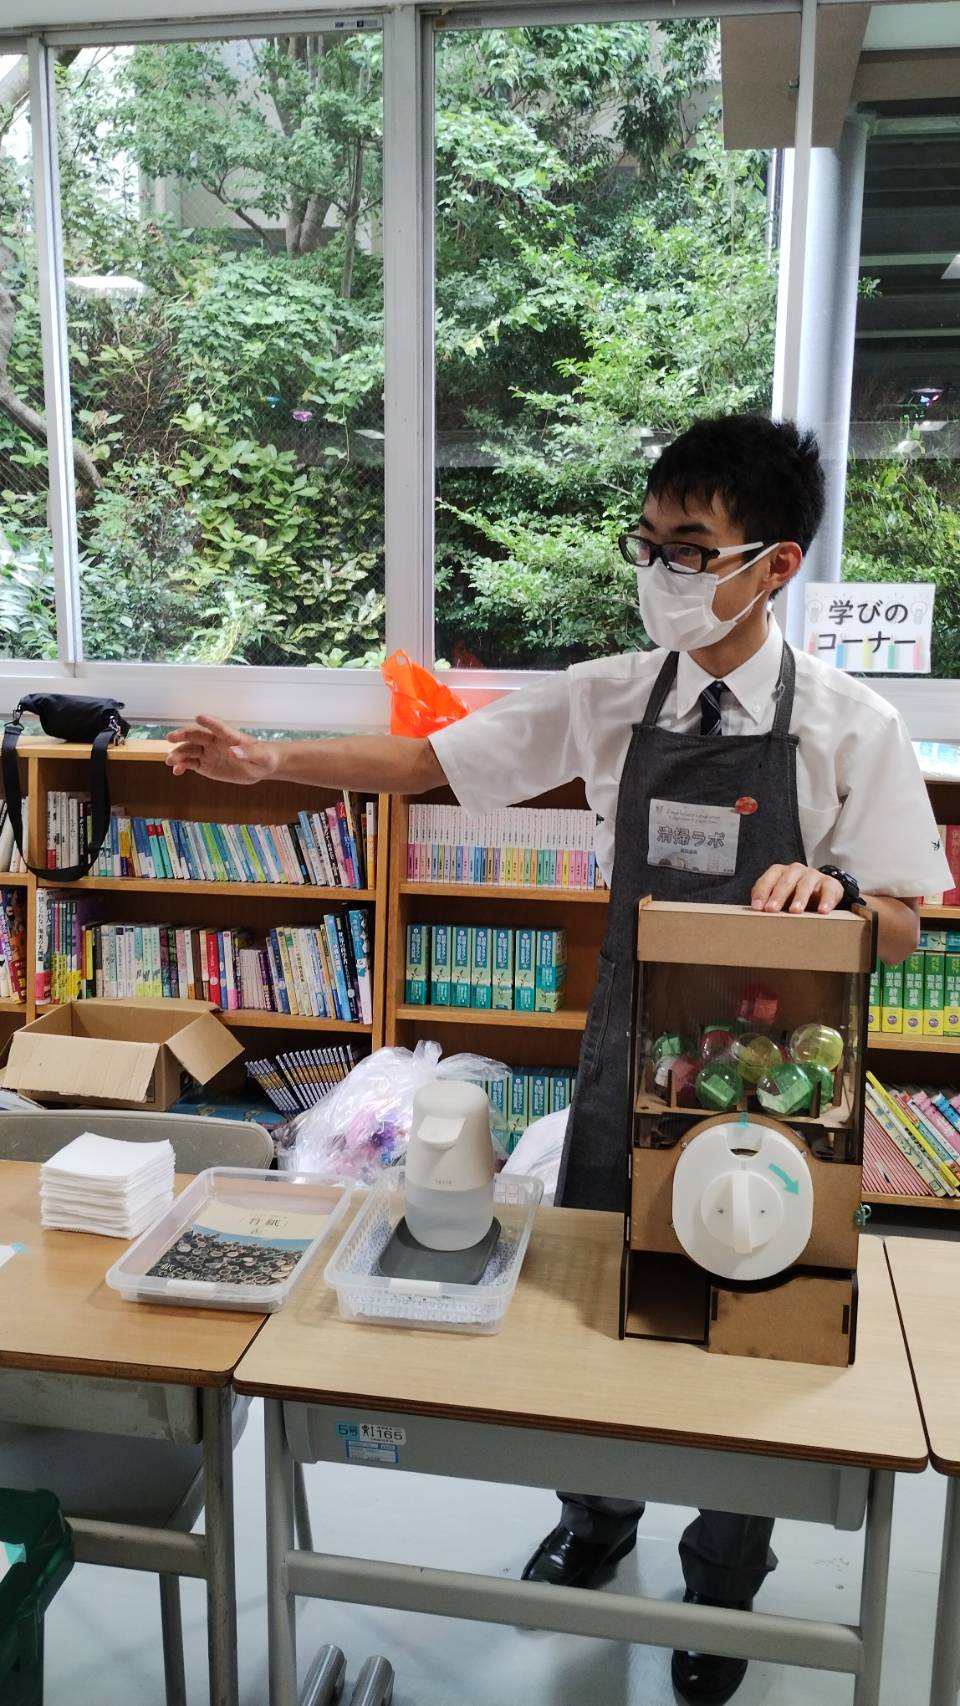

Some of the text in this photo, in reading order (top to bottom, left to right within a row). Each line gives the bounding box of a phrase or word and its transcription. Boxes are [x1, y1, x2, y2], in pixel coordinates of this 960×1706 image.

[828, 599, 908, 626] 学びの
[817, 630, 916, 653] コーナー
